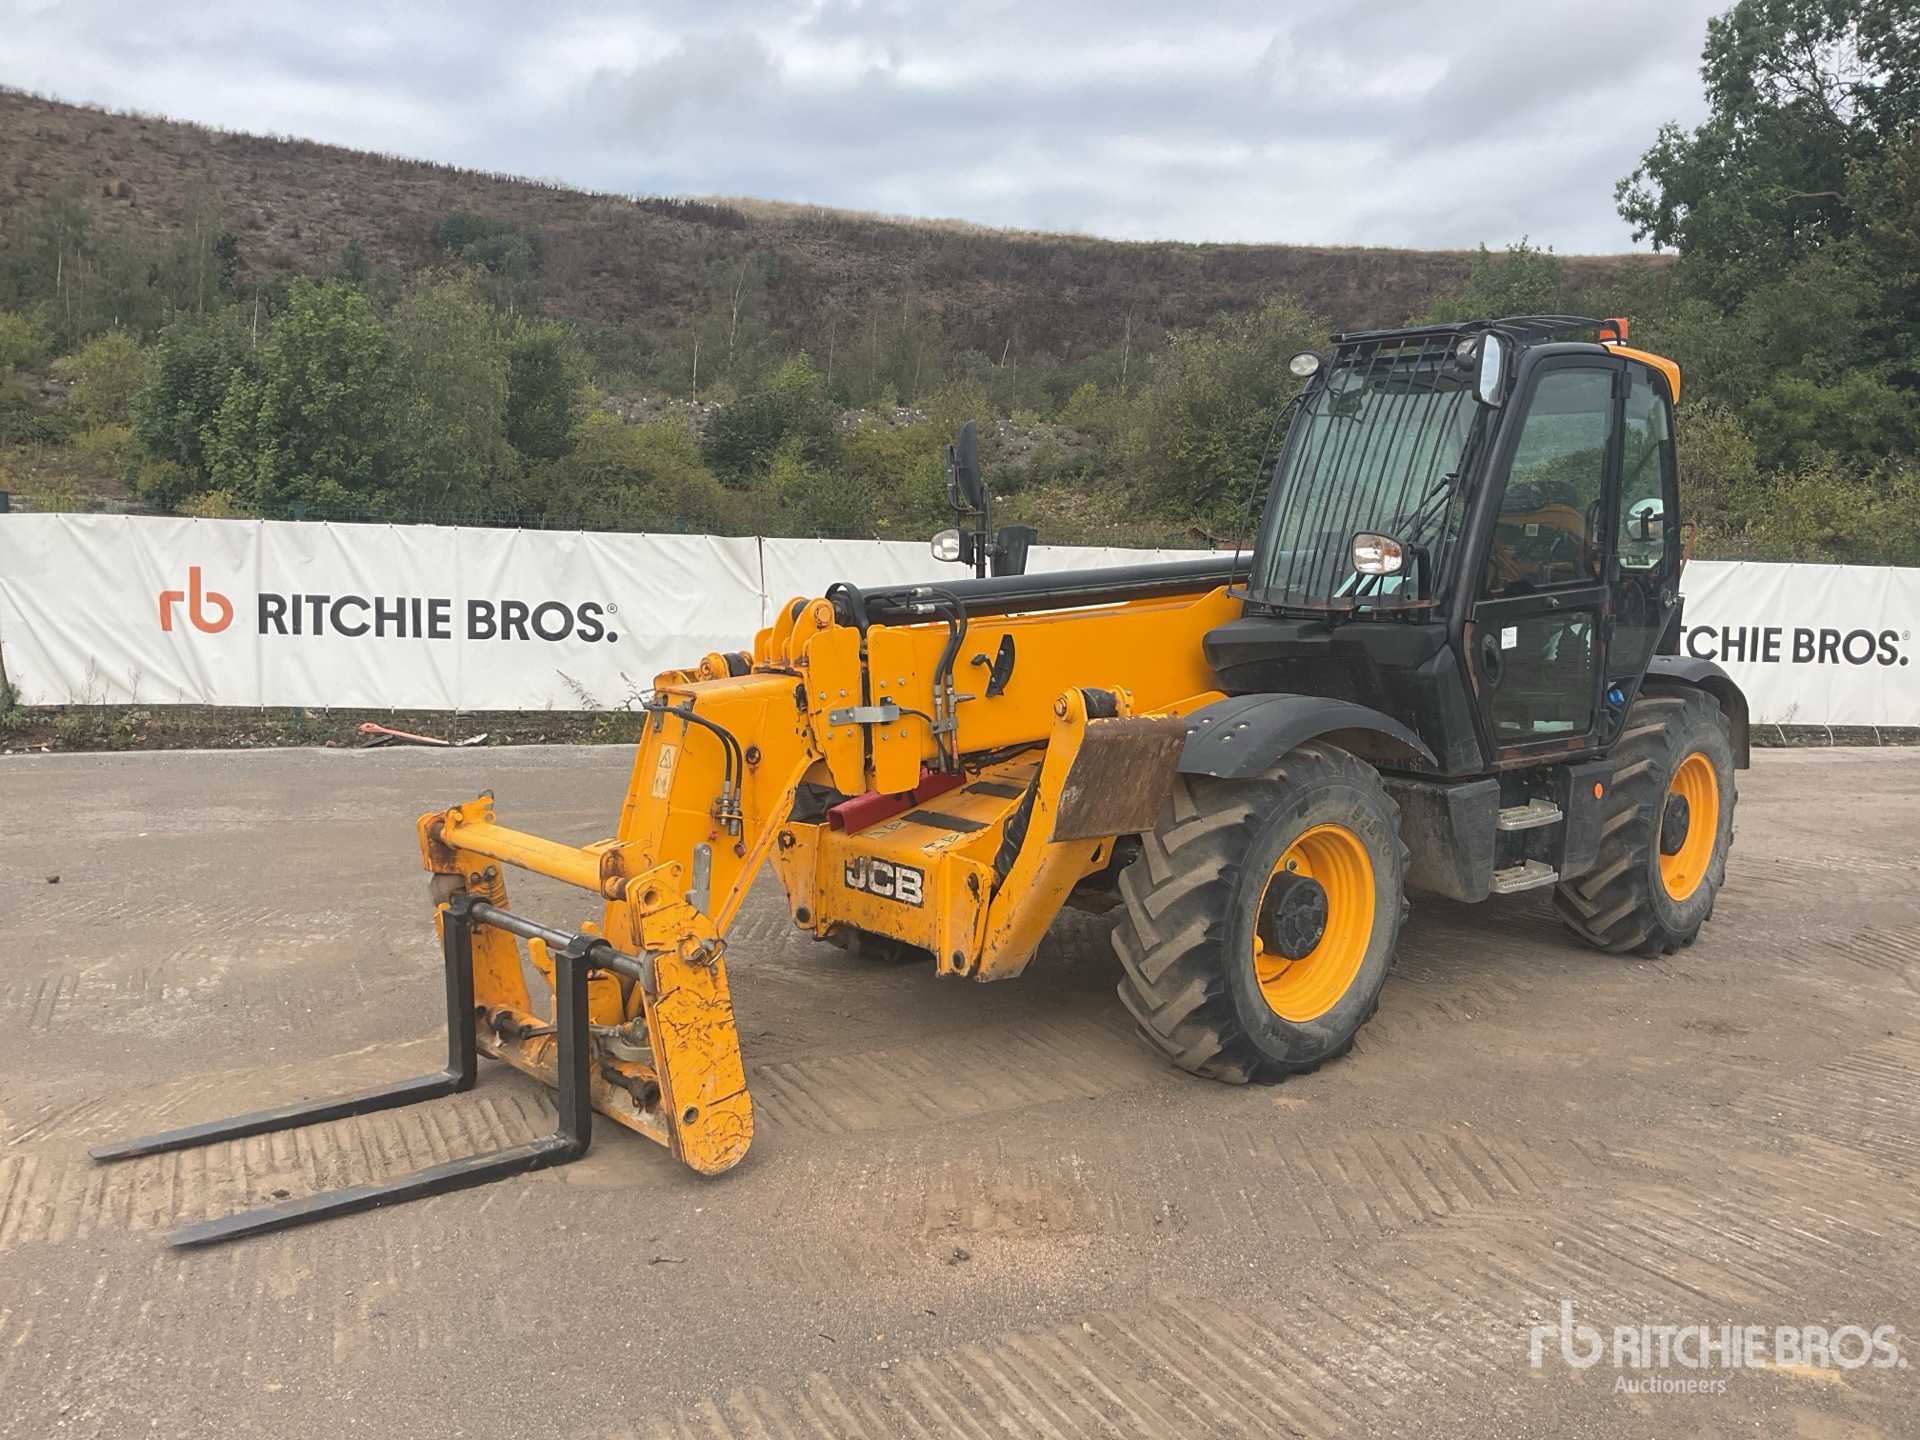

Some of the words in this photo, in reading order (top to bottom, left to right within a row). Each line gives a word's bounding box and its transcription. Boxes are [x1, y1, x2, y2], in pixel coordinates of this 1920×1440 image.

[159, 566, 234, 634] rb
[258, 593, 452, 640] RITCHIE
[467, 599, 618, 643] BROS.
[1792, 627, 1909, 666] BROS.
[846, 855, 922, 904] JCB
